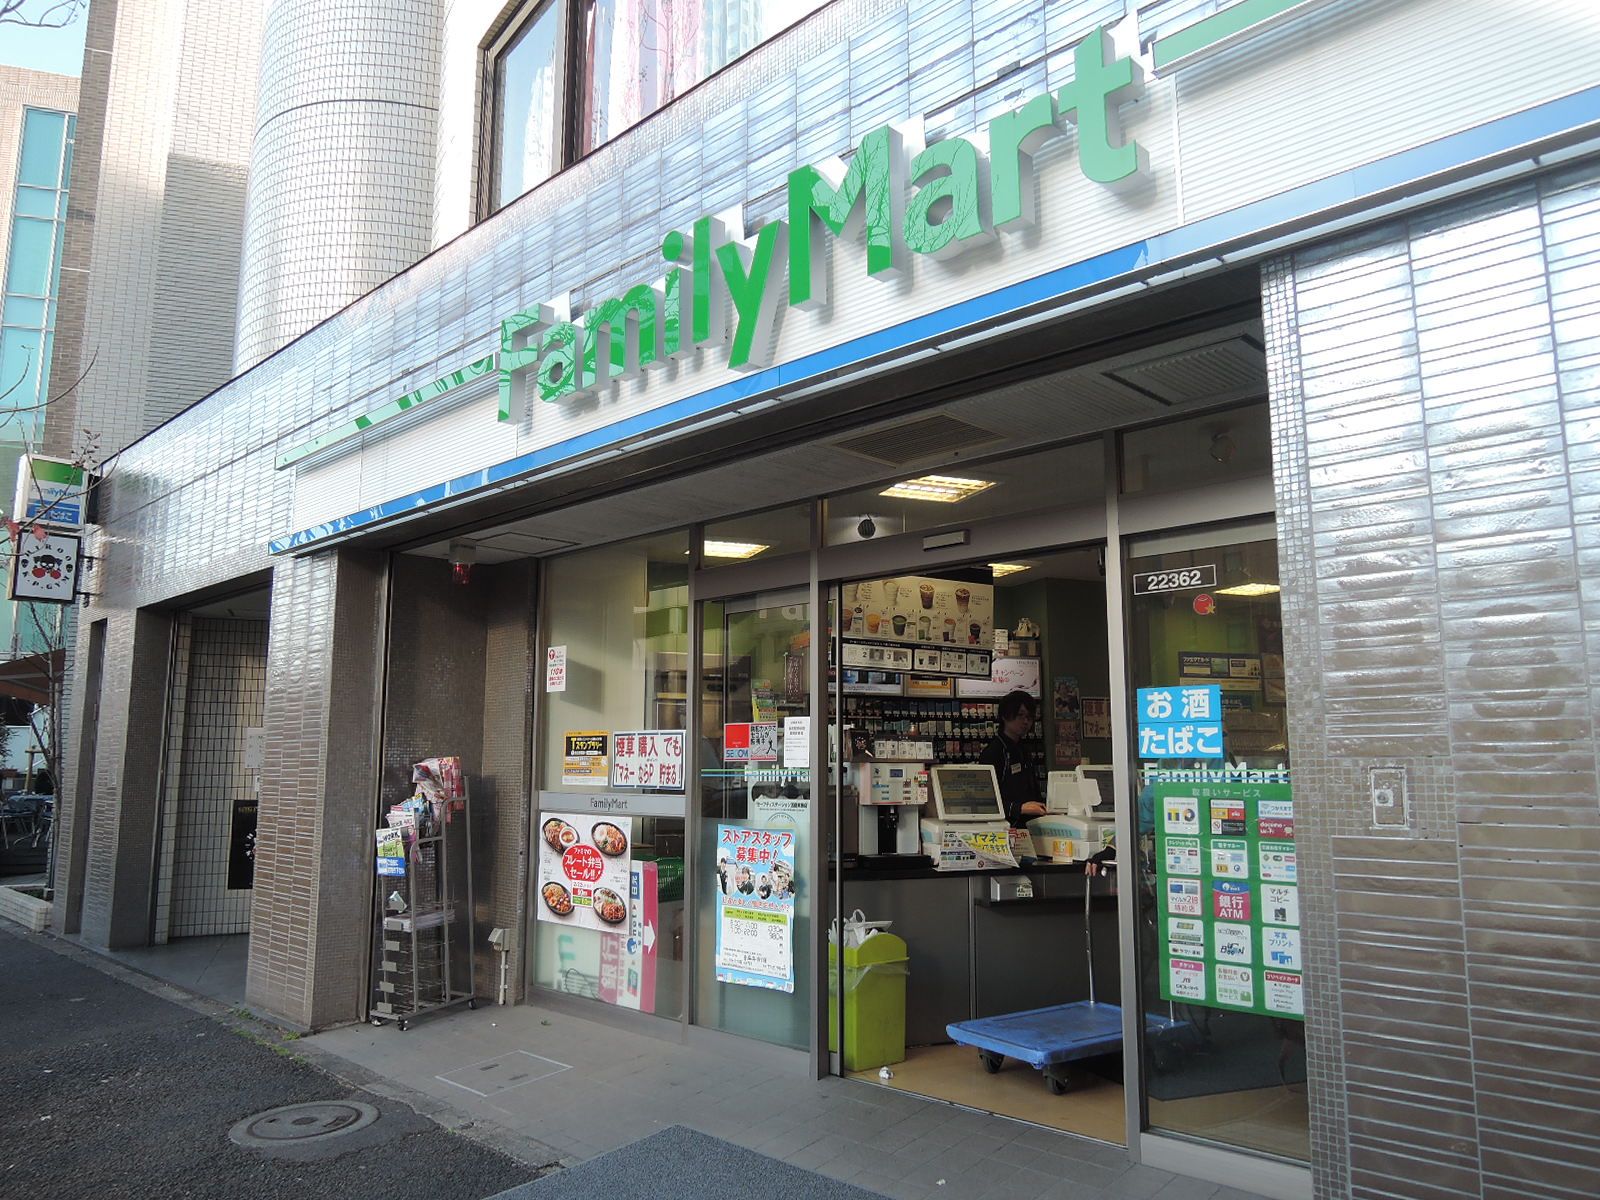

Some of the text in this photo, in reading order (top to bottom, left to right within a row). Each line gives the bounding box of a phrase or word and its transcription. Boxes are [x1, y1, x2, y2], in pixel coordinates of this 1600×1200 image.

[498, 25, 1138, 423] FamilyMart
[1147, 570, 1201, 590] 22362
[1146, 688, 1210, 719] お酒
[1140, 725, 1221, 754] たばこ
[1143, 762, 1289, 786] FamilyMart
[1191, 787, 1262, 798] 取扱いサービス
[590, 797, 628, 811] FamilyMart
[722, 829, 793, 848] ストアスタッフ
[564, 854, 602, 868] プレート弁当
[736, 845, 779, 865] 募集中!
[1269, 887, 1289, 895] マルチ
[1218, 895, 1244, 909] 銀行
[1269, 896, 1290, 904] コピー
[1219, 908, 1243, 919] ATM
[1273, 931, 1288, 940] 写真
[1269, 939, 1294, 948] プリント
